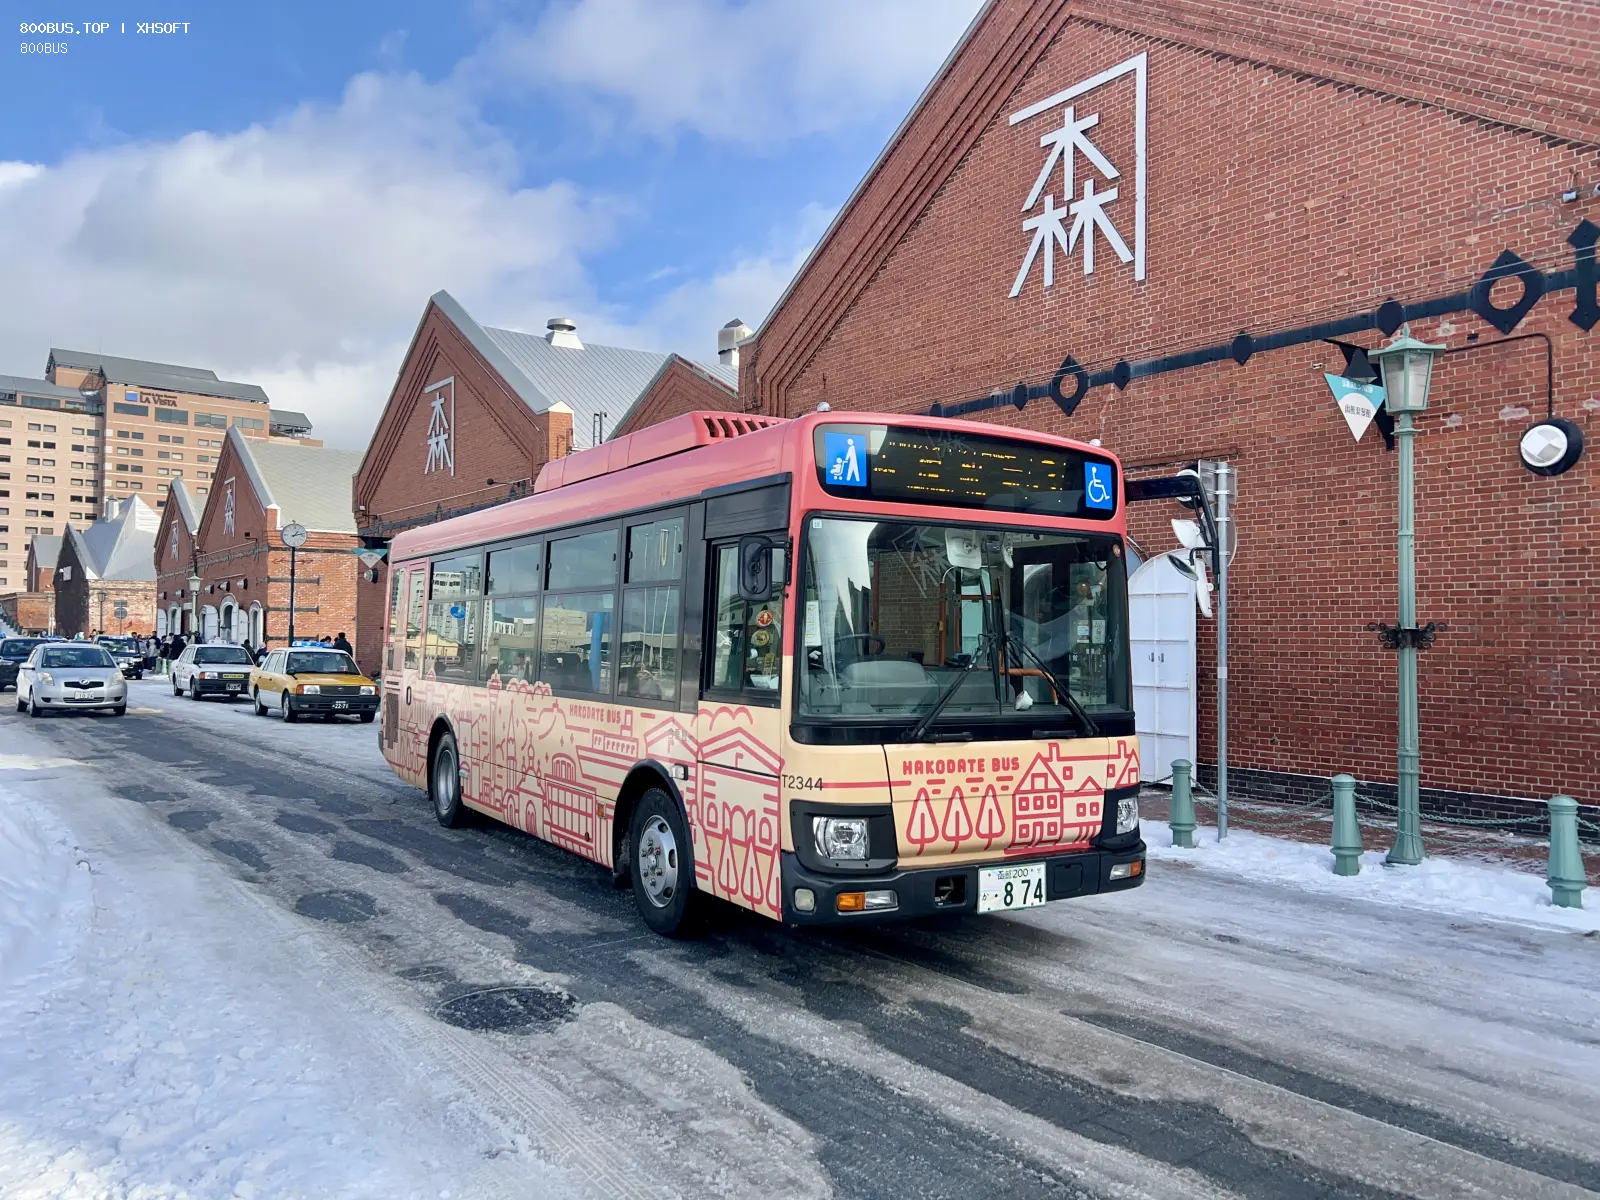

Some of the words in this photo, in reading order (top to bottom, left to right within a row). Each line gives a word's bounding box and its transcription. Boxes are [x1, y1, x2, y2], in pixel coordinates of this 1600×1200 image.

[140, 395, 151, 404] LA
[152, 396, 177, 407] VISTA
[569, 704, 605, 722] HAKODATE
[606, 709, 621, 724] BUS
[902, 758, 985, 776] HAKODATE
[992, 756, 1020, 772] BUS
[782, 774, 824, 791] T2344
[1012, 868, 1029, 879] 200
